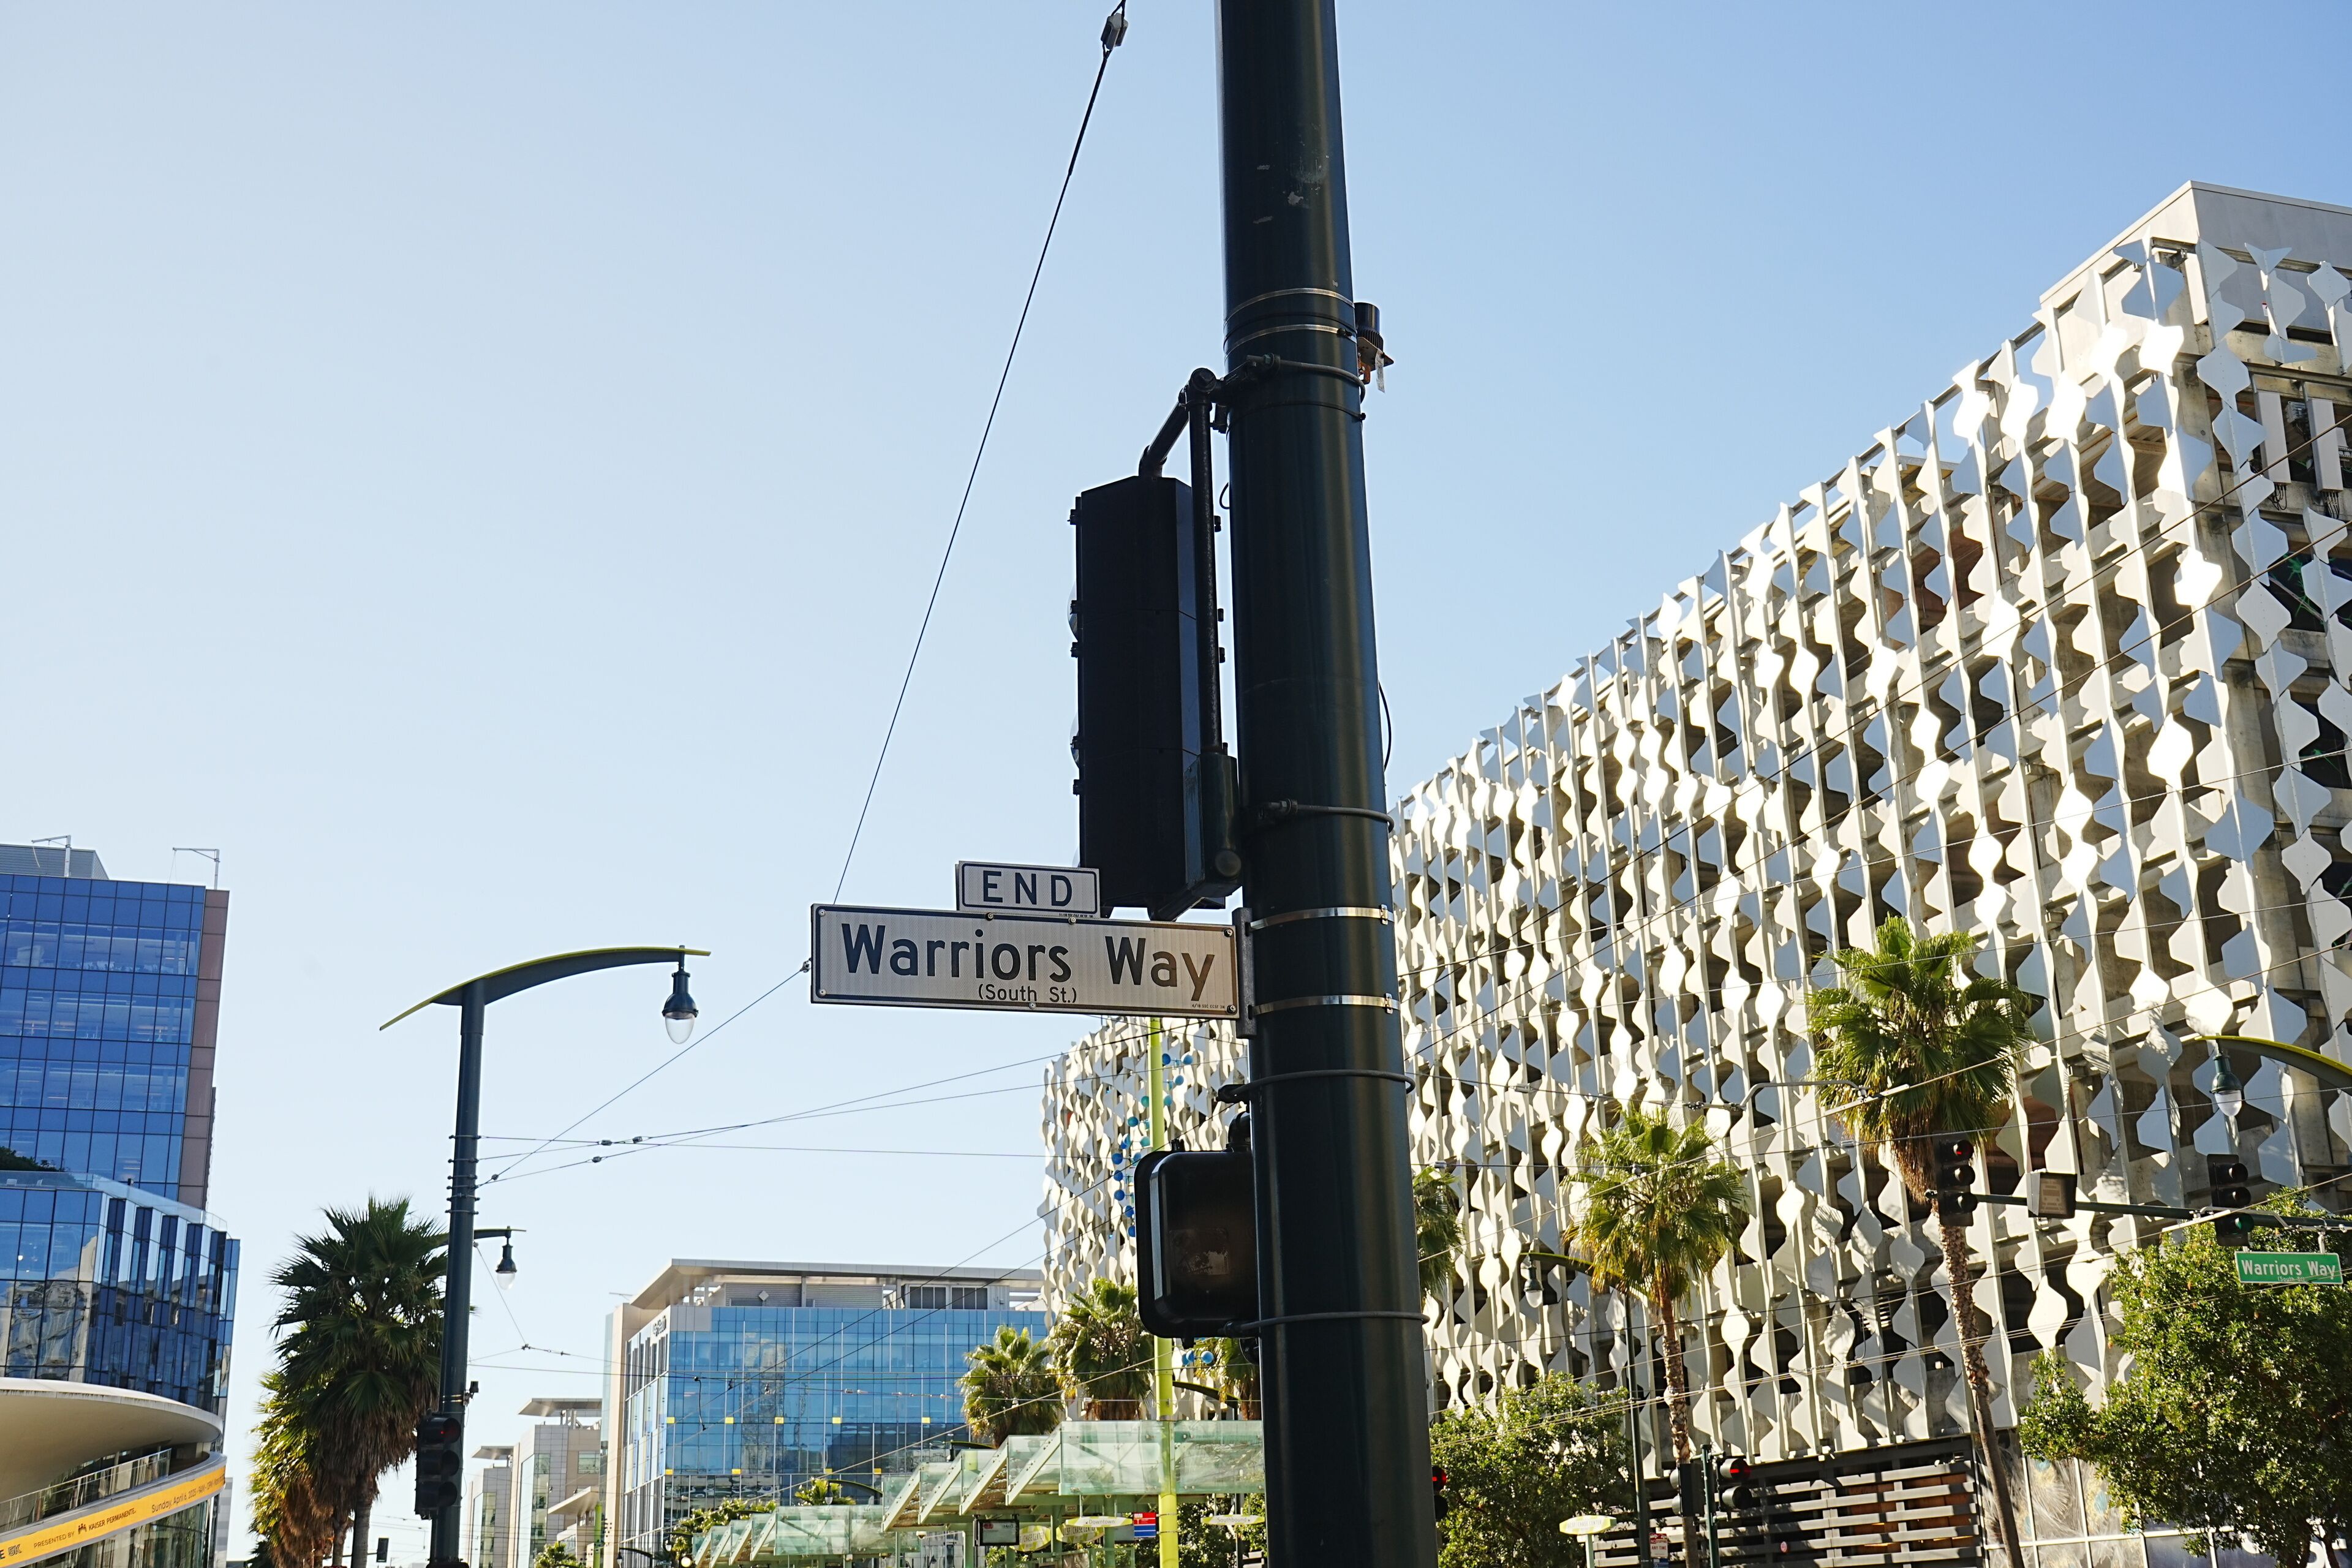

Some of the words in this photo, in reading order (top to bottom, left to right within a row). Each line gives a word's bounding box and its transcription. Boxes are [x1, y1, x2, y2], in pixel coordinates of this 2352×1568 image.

[982, 870, 1072, 907] END
[840, 922, 1073, 982] Warriors
[1104, 935, 1215, 1001] Way
[978, 984, 1037, 1002] (South
[1049, 986, 1077, 1003] St.)
[2241, 1260, 2302, 1276] Warriors
[2307, 1261, 2336, 1280] Way
[173, 1493, 184, 1506] April
[88, 1519, 105, 1531] KAISER
[34, 1534, 67, 1549] PRESENTED
[67, 1530, 75, 1539] BY
[8, 1544, 22, 1556] 5K
